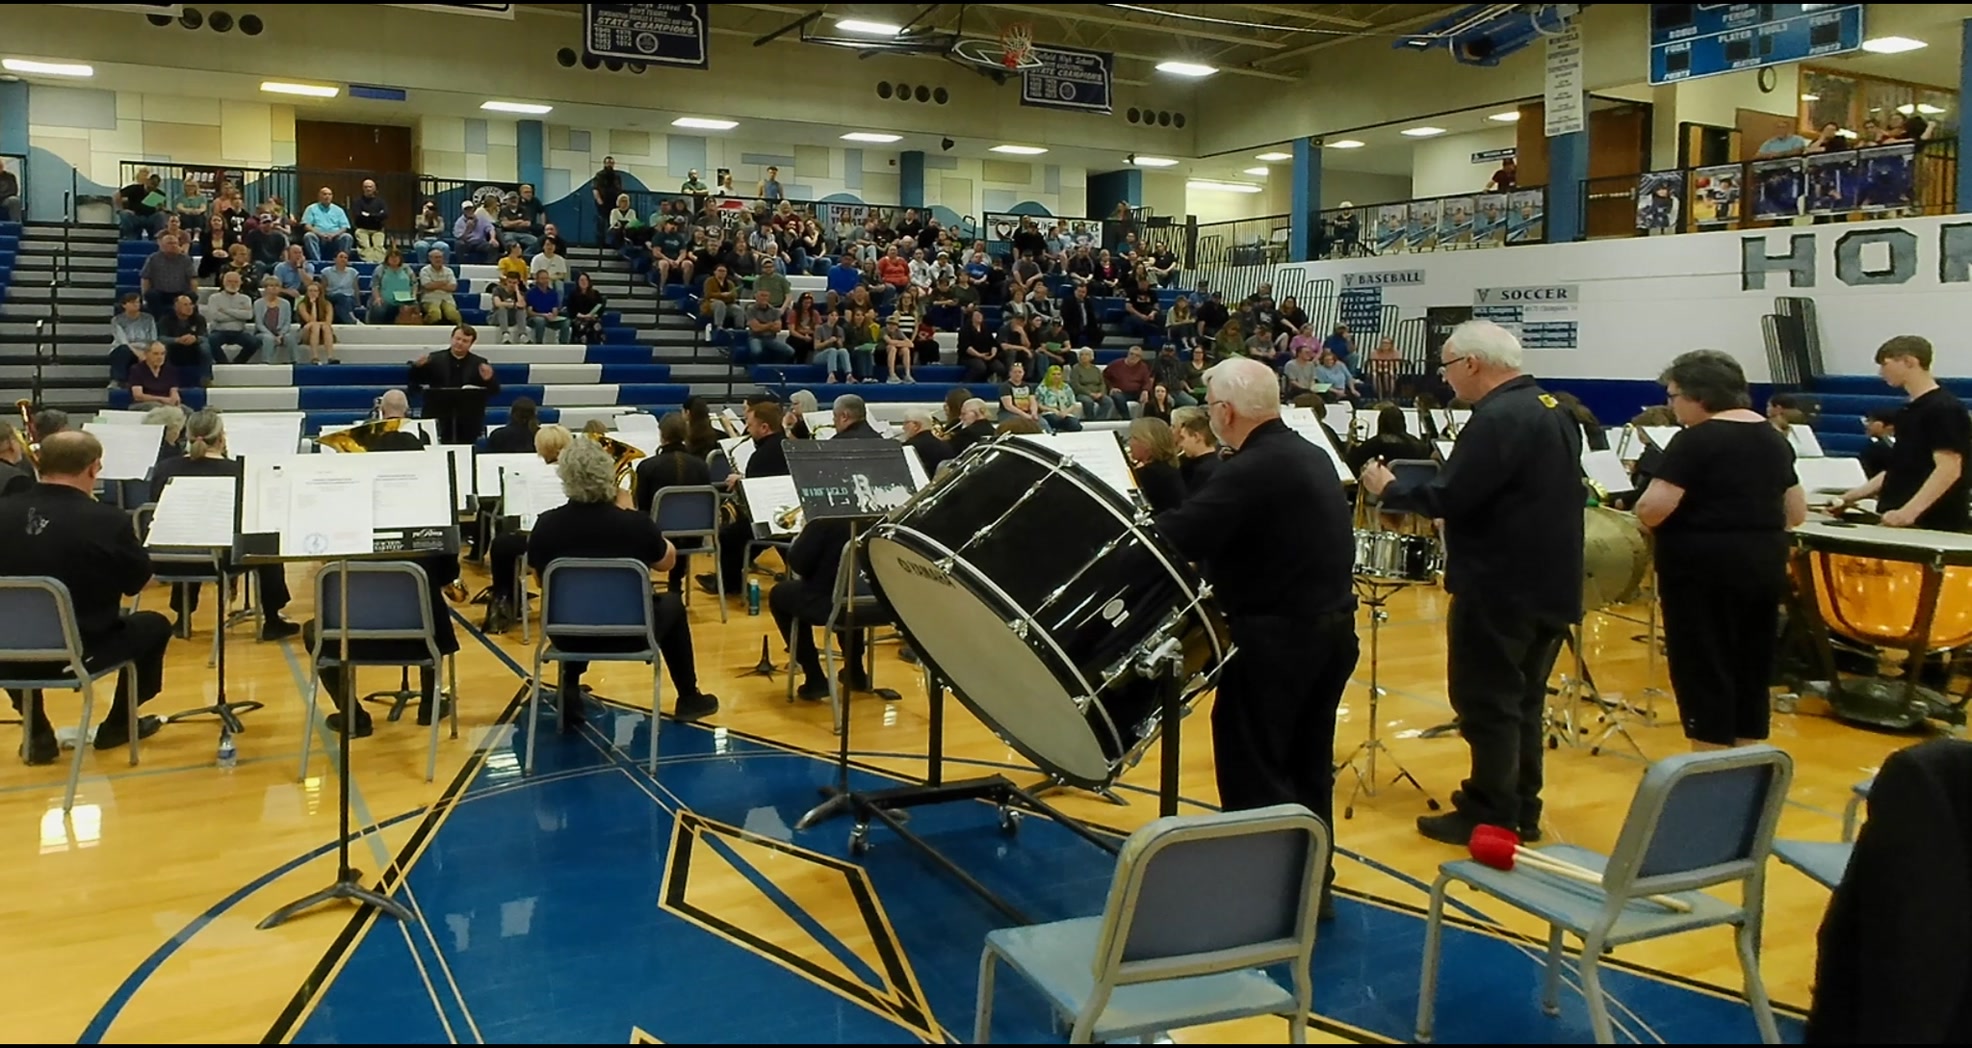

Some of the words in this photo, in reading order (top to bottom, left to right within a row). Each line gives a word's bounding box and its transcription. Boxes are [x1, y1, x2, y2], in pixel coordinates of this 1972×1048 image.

[596, 17, 630, 27] STATE
[633, 21, 694, 34] CHAMPIONS
[1718, 30, 1752, 43] PLAYER
[1758, 24, 1788, 35] FOULS
[1664, 42, 1691, 54] FOULS
[1358, 271, 1422, 285] BASEBALL
[1501, 288, 1568, 301] SOCCER
[906, 560, 956, 589] YAMAHA
